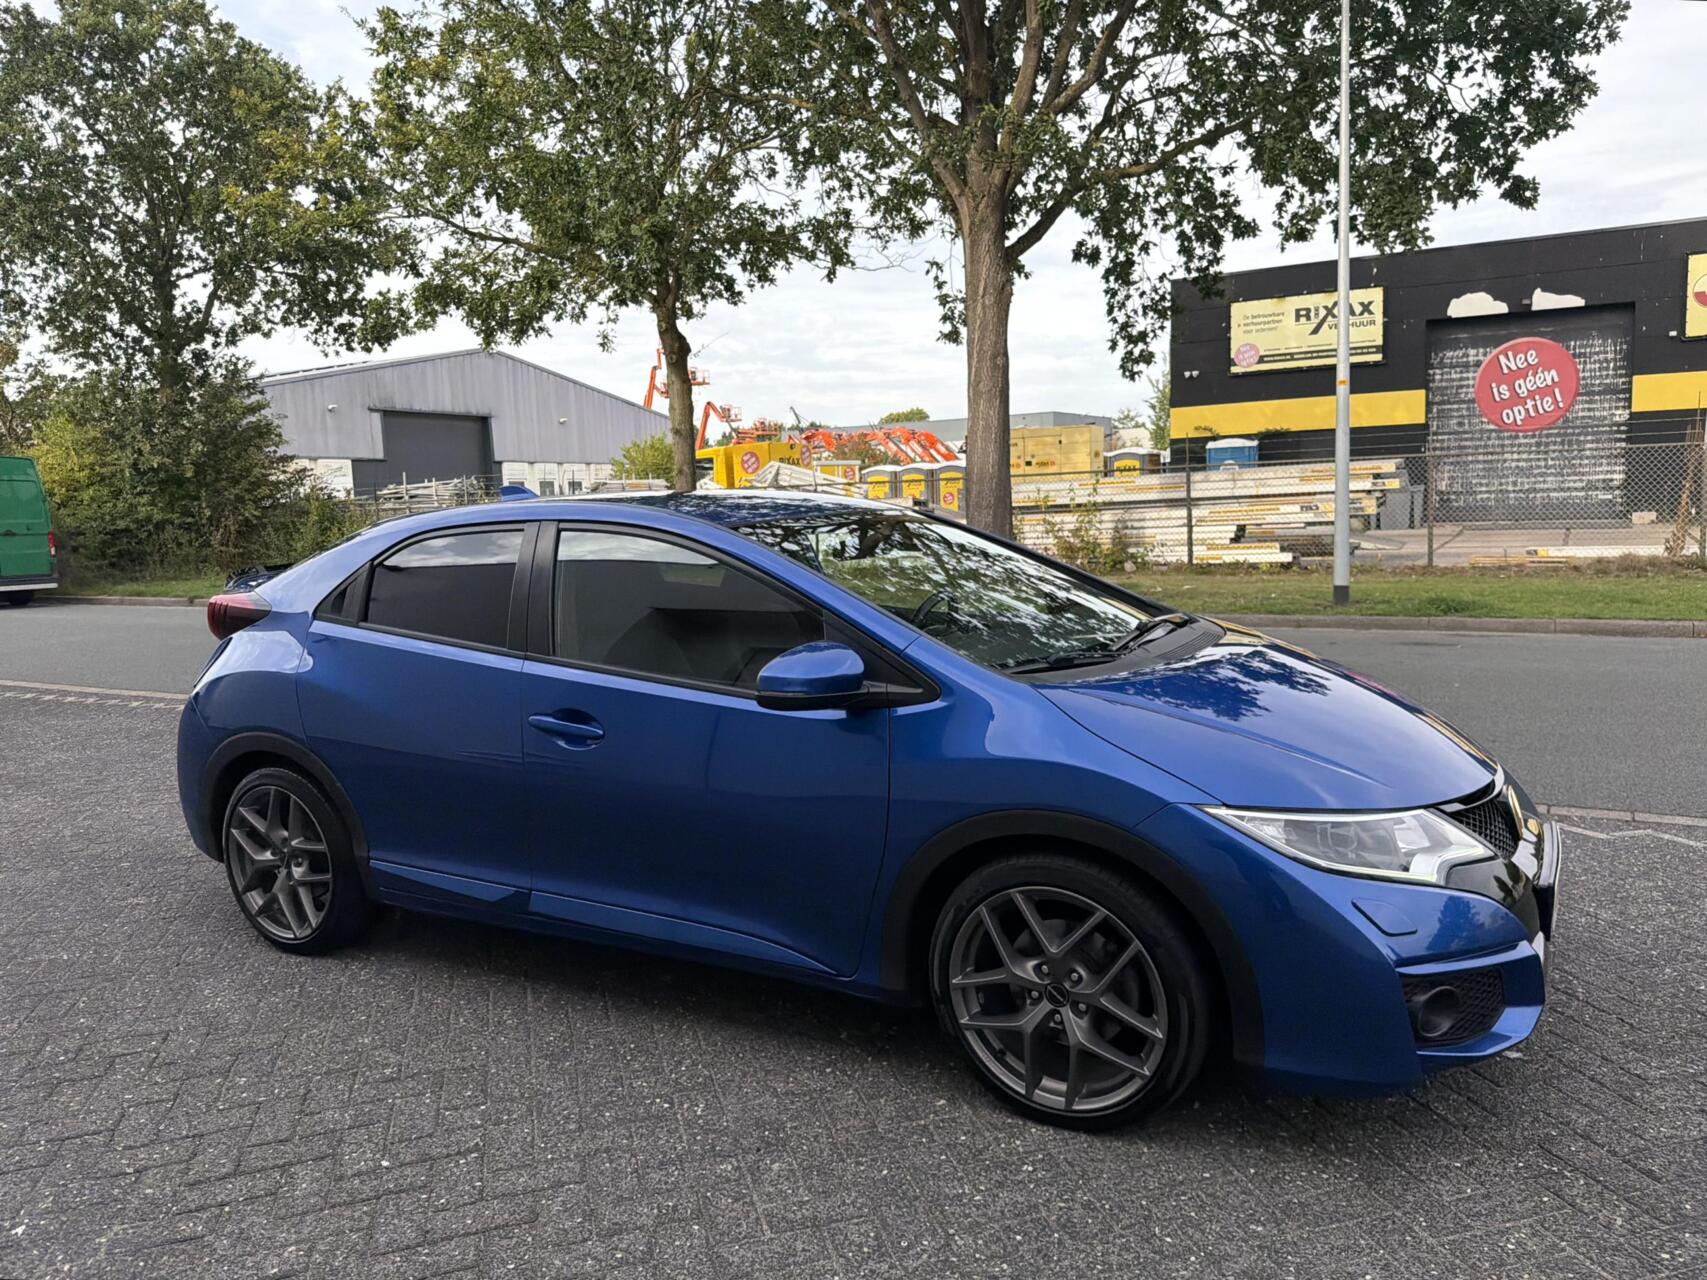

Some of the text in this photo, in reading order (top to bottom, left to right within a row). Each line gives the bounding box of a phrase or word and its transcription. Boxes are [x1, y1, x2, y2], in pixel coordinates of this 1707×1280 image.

[1498, 349, 1538, 374] Nee
[1491, 367, 1559, 401] is géén
